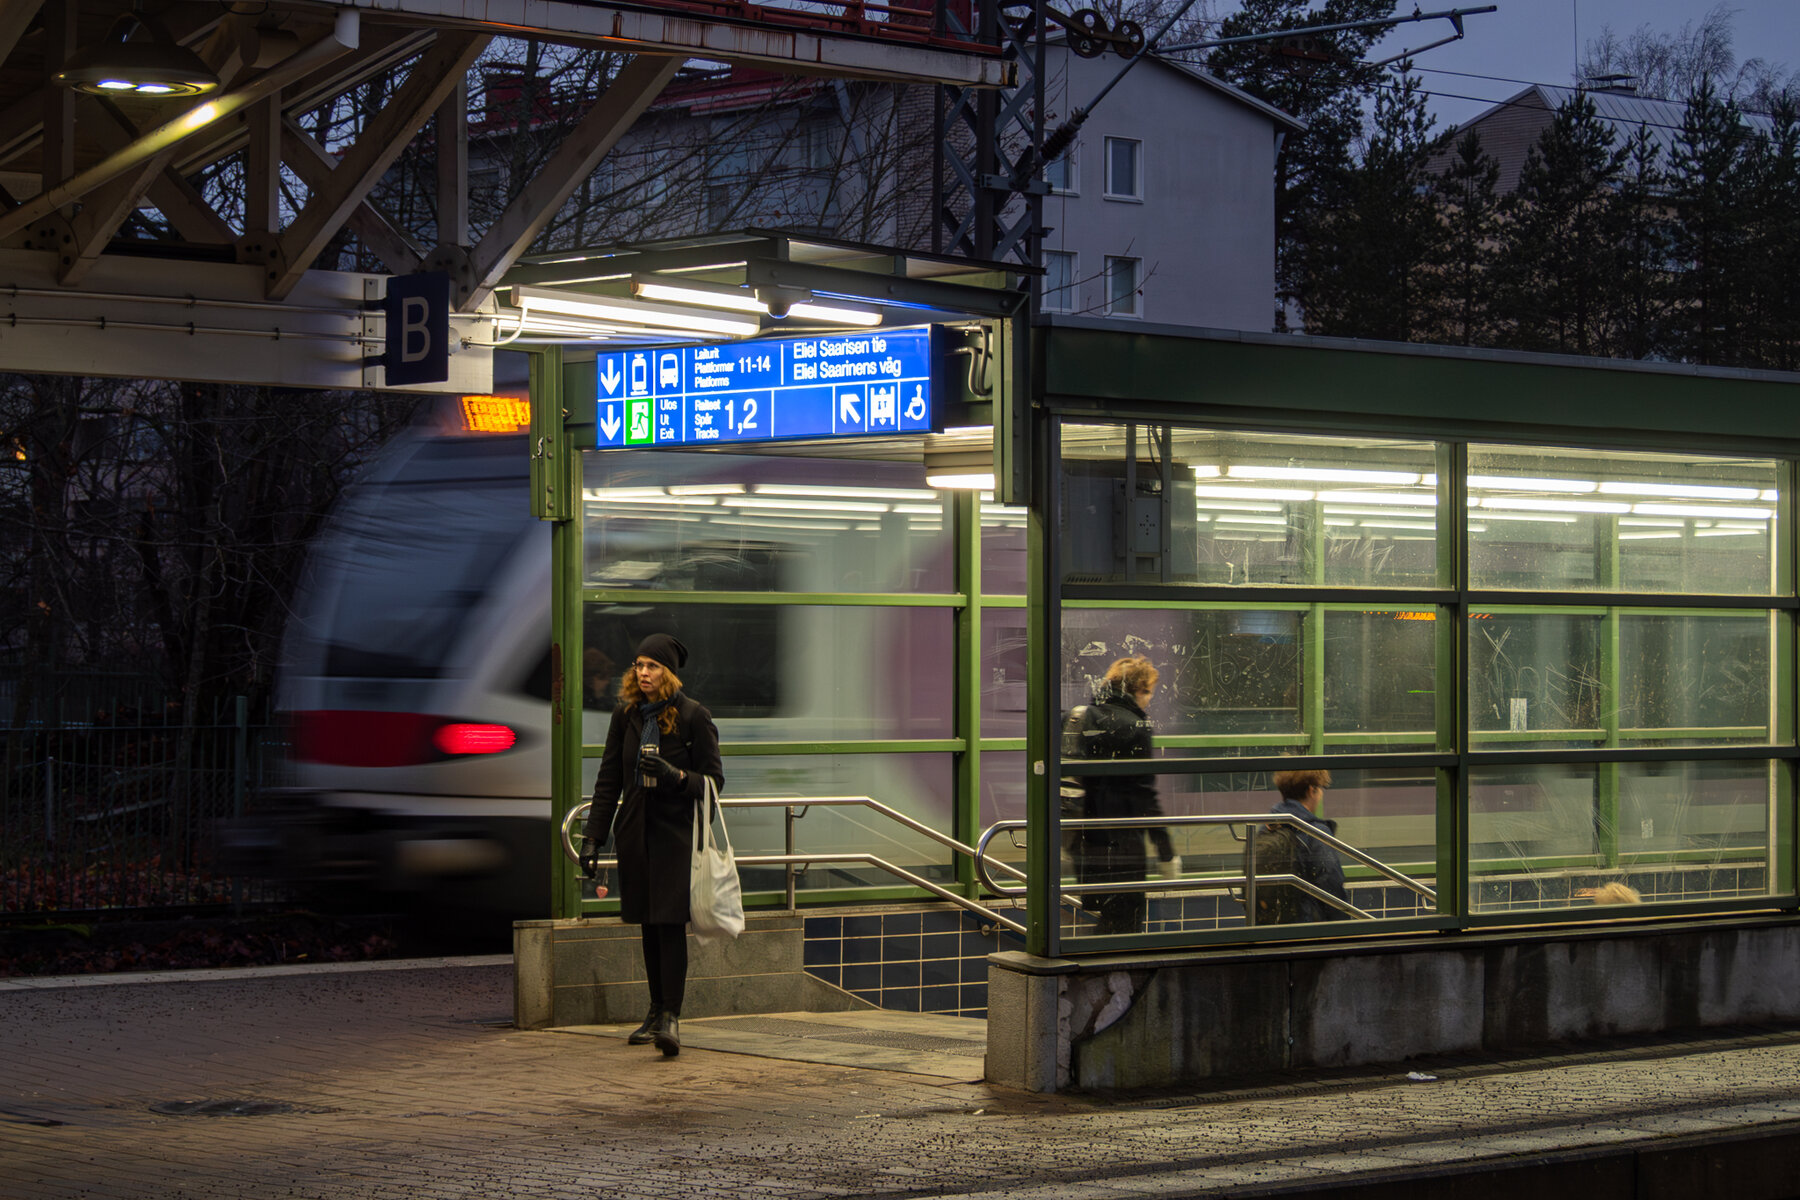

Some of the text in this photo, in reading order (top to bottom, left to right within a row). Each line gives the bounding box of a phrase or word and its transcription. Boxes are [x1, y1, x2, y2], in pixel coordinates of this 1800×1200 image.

[402, 296, 431, 363] B
[694, 347, 720, 360] Laiturit
[793, 336, 887, 359] Eliel Saarisen tie
[738, 355, 771, 373] 11-14
[793, 356, 901, 380] Eliel Saarinens väg
[694, 376, 730, 388] Platforms
[660, 399, 678, 411] Ulos
[660, 414, 670, 426] Ut
[694, 412, 713, 428] Spår
[724, 398, 758, 435] 1,2
[659, 427, 675, 439] Exit
[694, 427, 719, 439] Tracks
